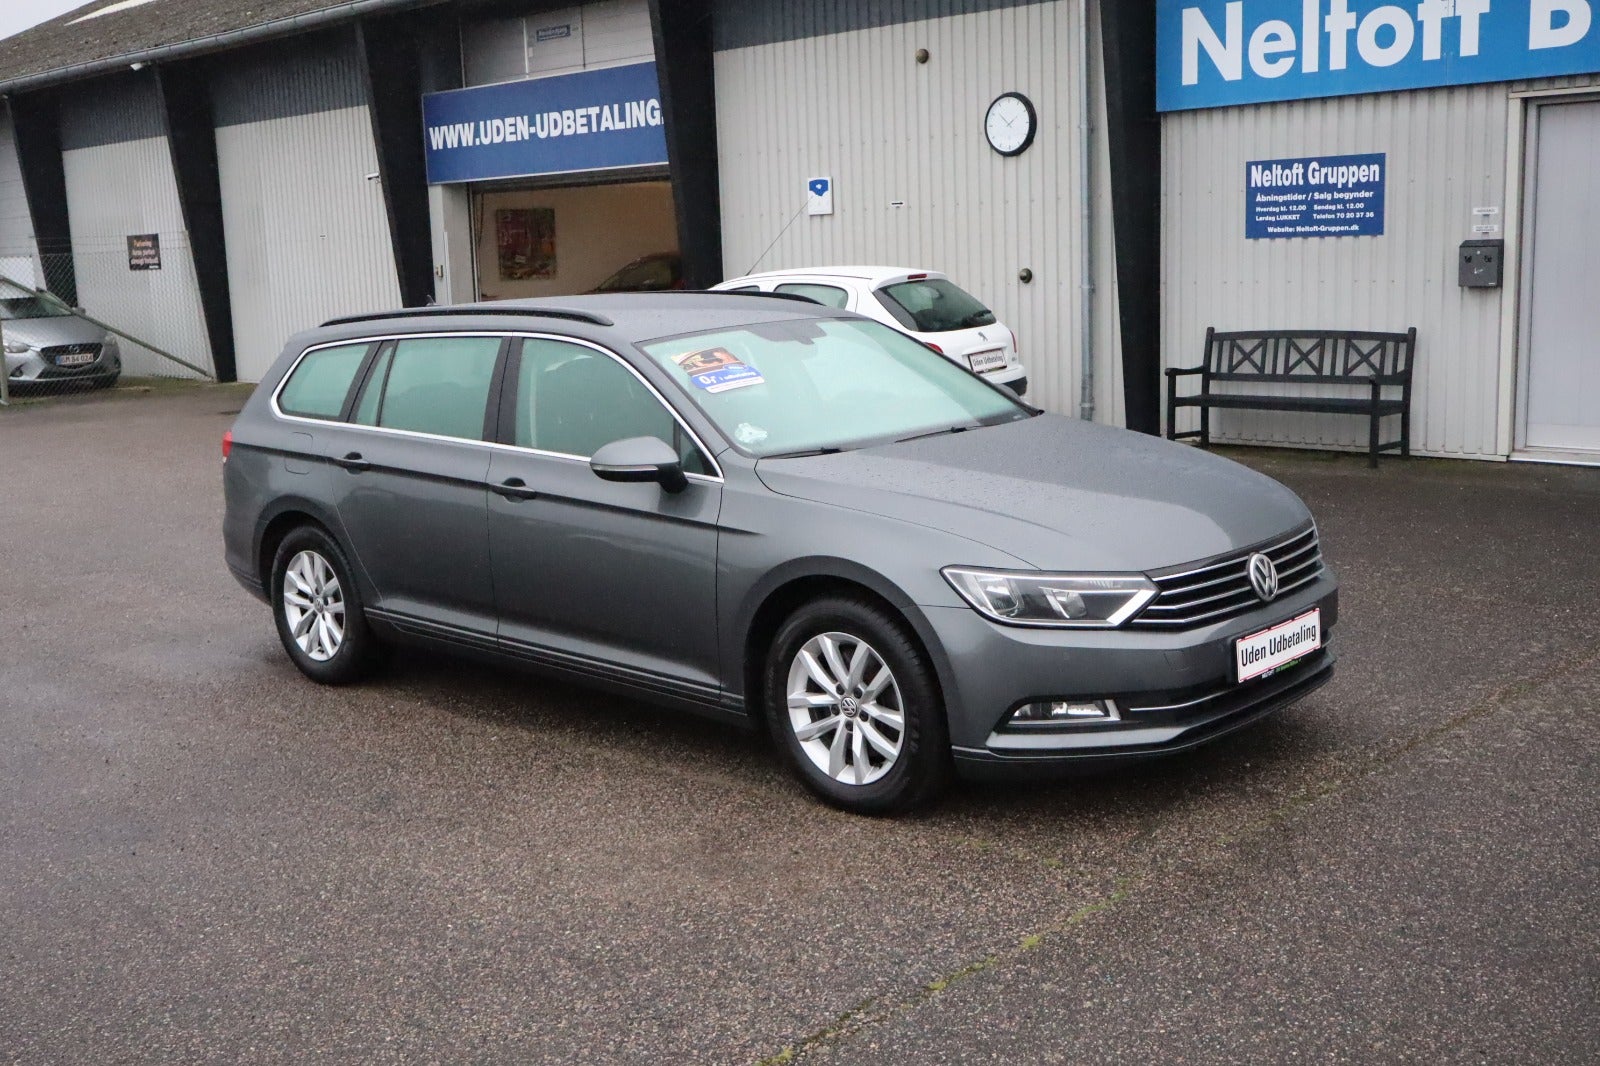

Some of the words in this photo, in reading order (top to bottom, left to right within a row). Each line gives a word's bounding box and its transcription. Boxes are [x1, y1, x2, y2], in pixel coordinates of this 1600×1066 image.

[1182, 0, 1491, 86] Neltoft
[1251, 163, 1304, 187] Neltoft
[1308, 161, 1380, 189] Gruppen
[1256, 192, 1307, 203] Åbningstider
[1313, 191, 1332, 201] Salg
[1333, 190, 1374, 200] begynder
[1296, 224, 1360, 233] Neltoft-Gruppen.dk
[1241, 645, 1267, 667] Uden
[1269, 624, 1317, 656] Udbetaling
